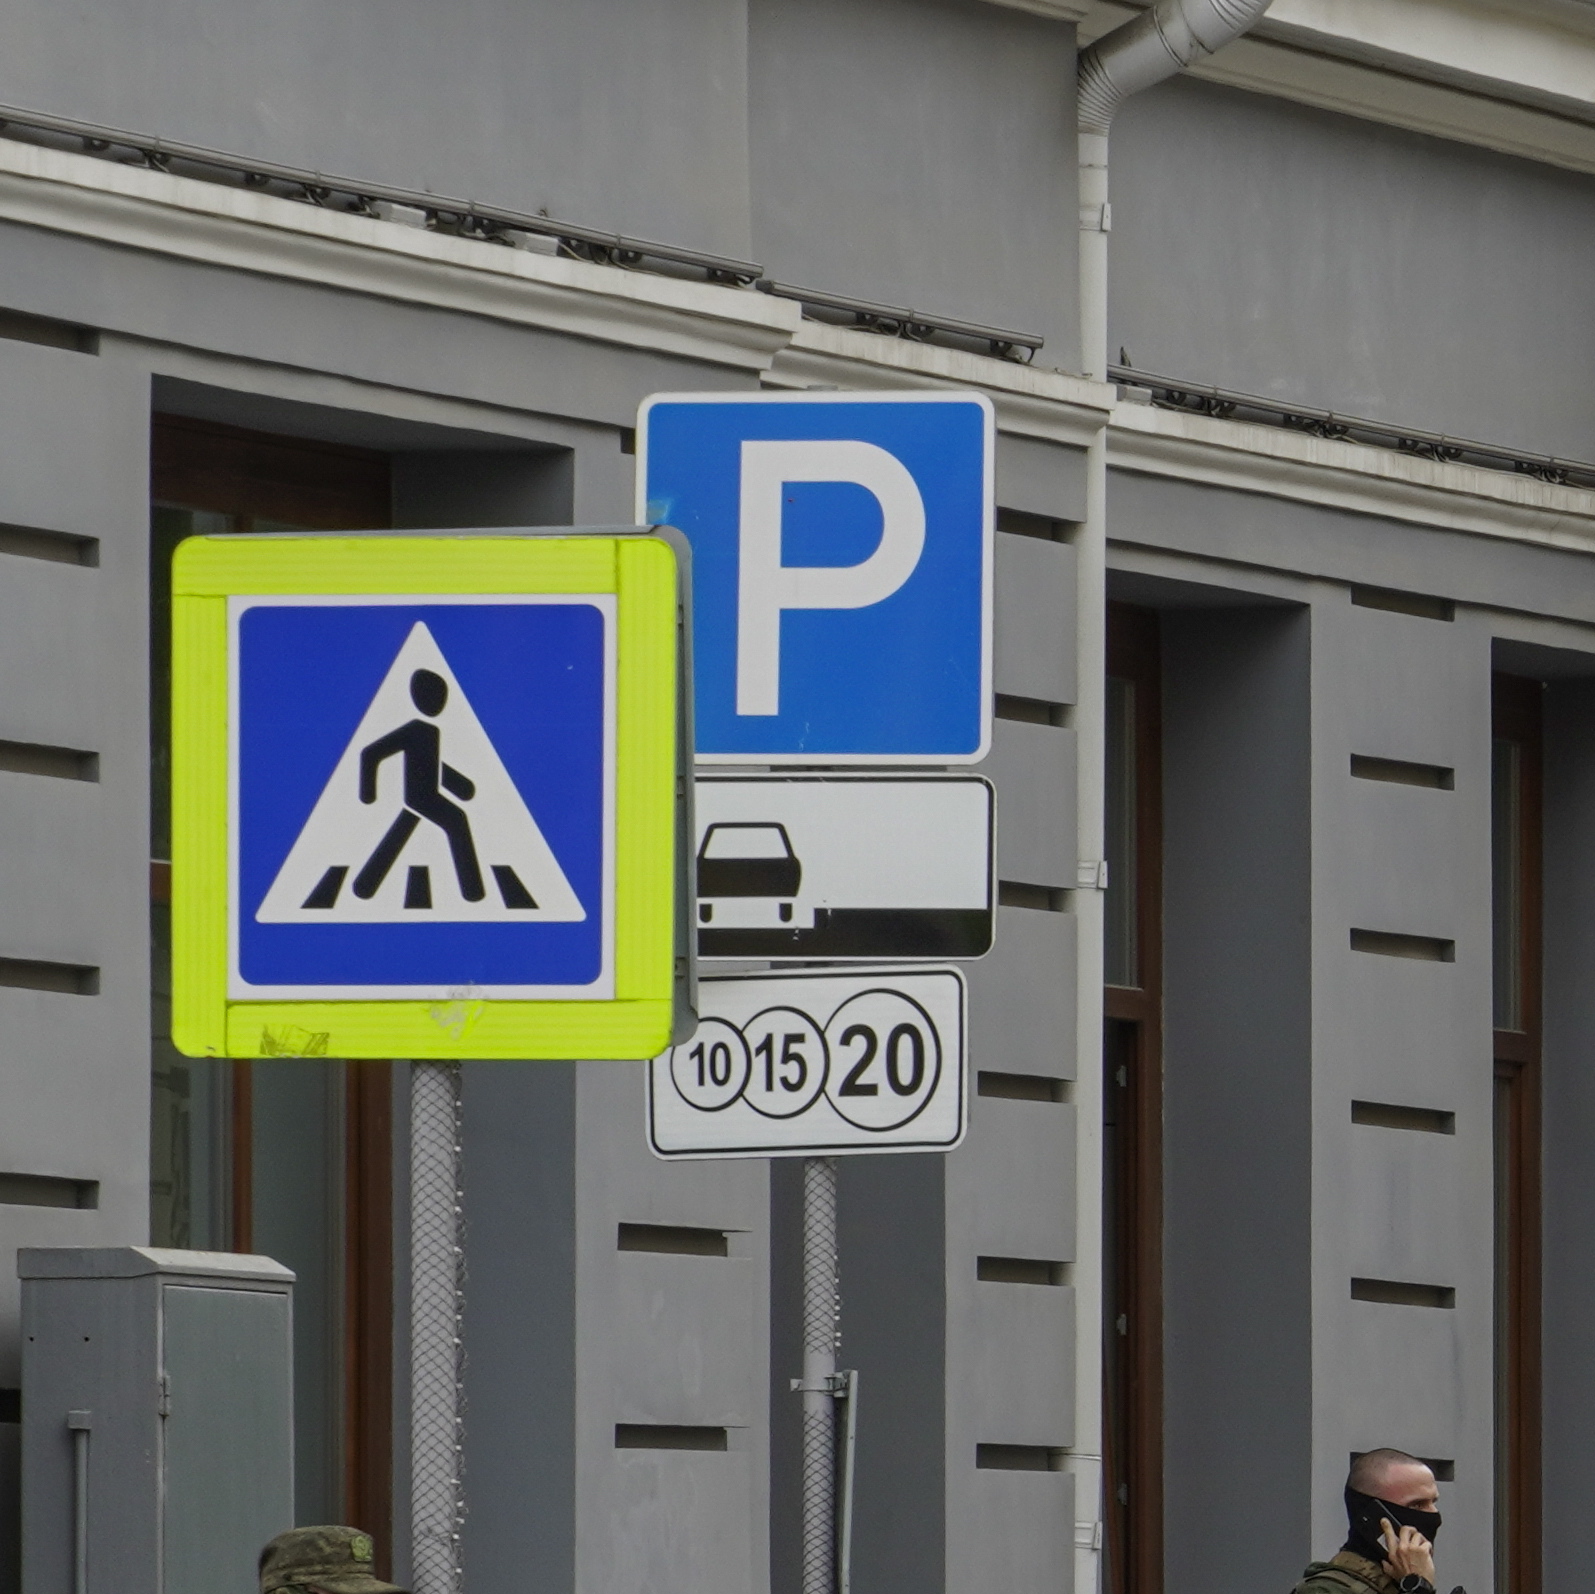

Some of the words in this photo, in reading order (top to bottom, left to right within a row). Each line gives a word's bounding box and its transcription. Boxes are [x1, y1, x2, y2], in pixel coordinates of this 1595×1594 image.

[736, 440, 926, 716] P
[689, 1041, 732, 1087] 10
[754, 1032, 808, 1092] 15
[838, 1022, 925, 1097] 20
